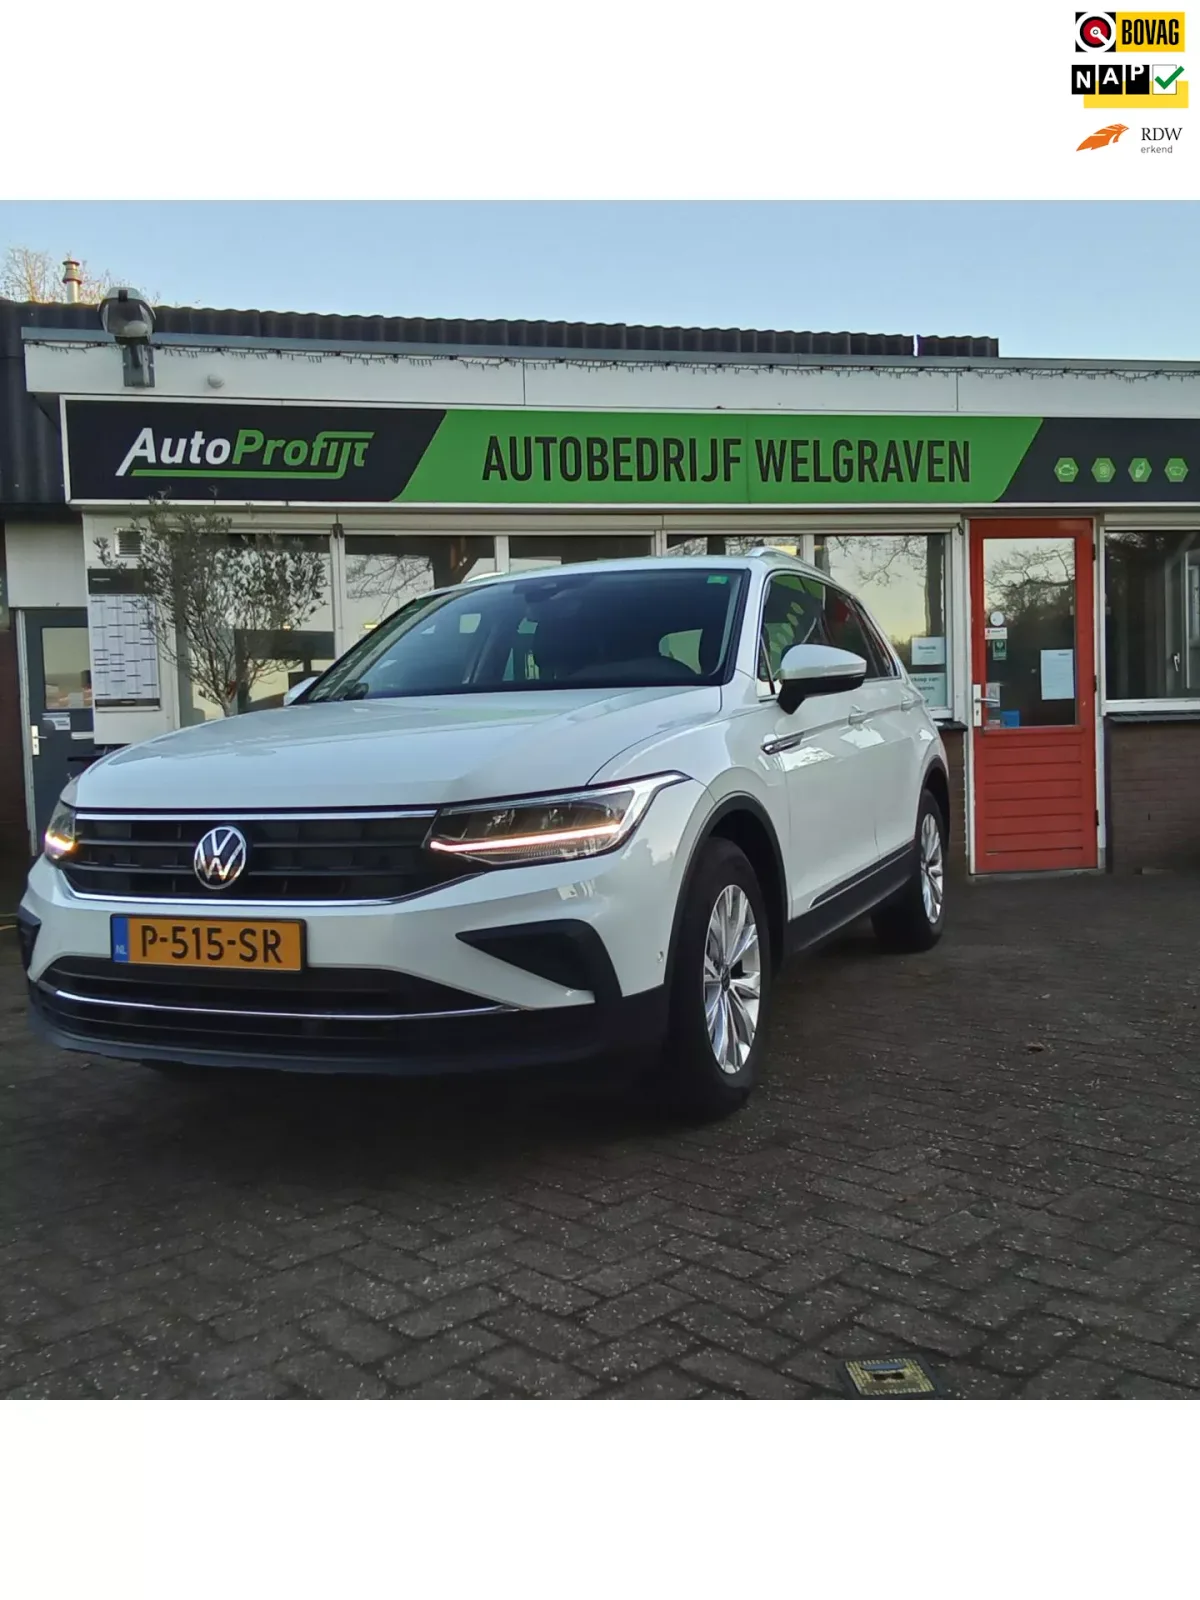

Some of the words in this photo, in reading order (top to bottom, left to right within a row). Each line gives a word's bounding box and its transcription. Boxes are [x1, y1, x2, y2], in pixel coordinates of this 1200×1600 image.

[481, 435, 742, 482] AUTOBEDRIJF
[754, 438, 970, 483] WELGRAVEN
[114, 945, 128, 956] NL
[141, 924, 283, 964] P-515-SR
